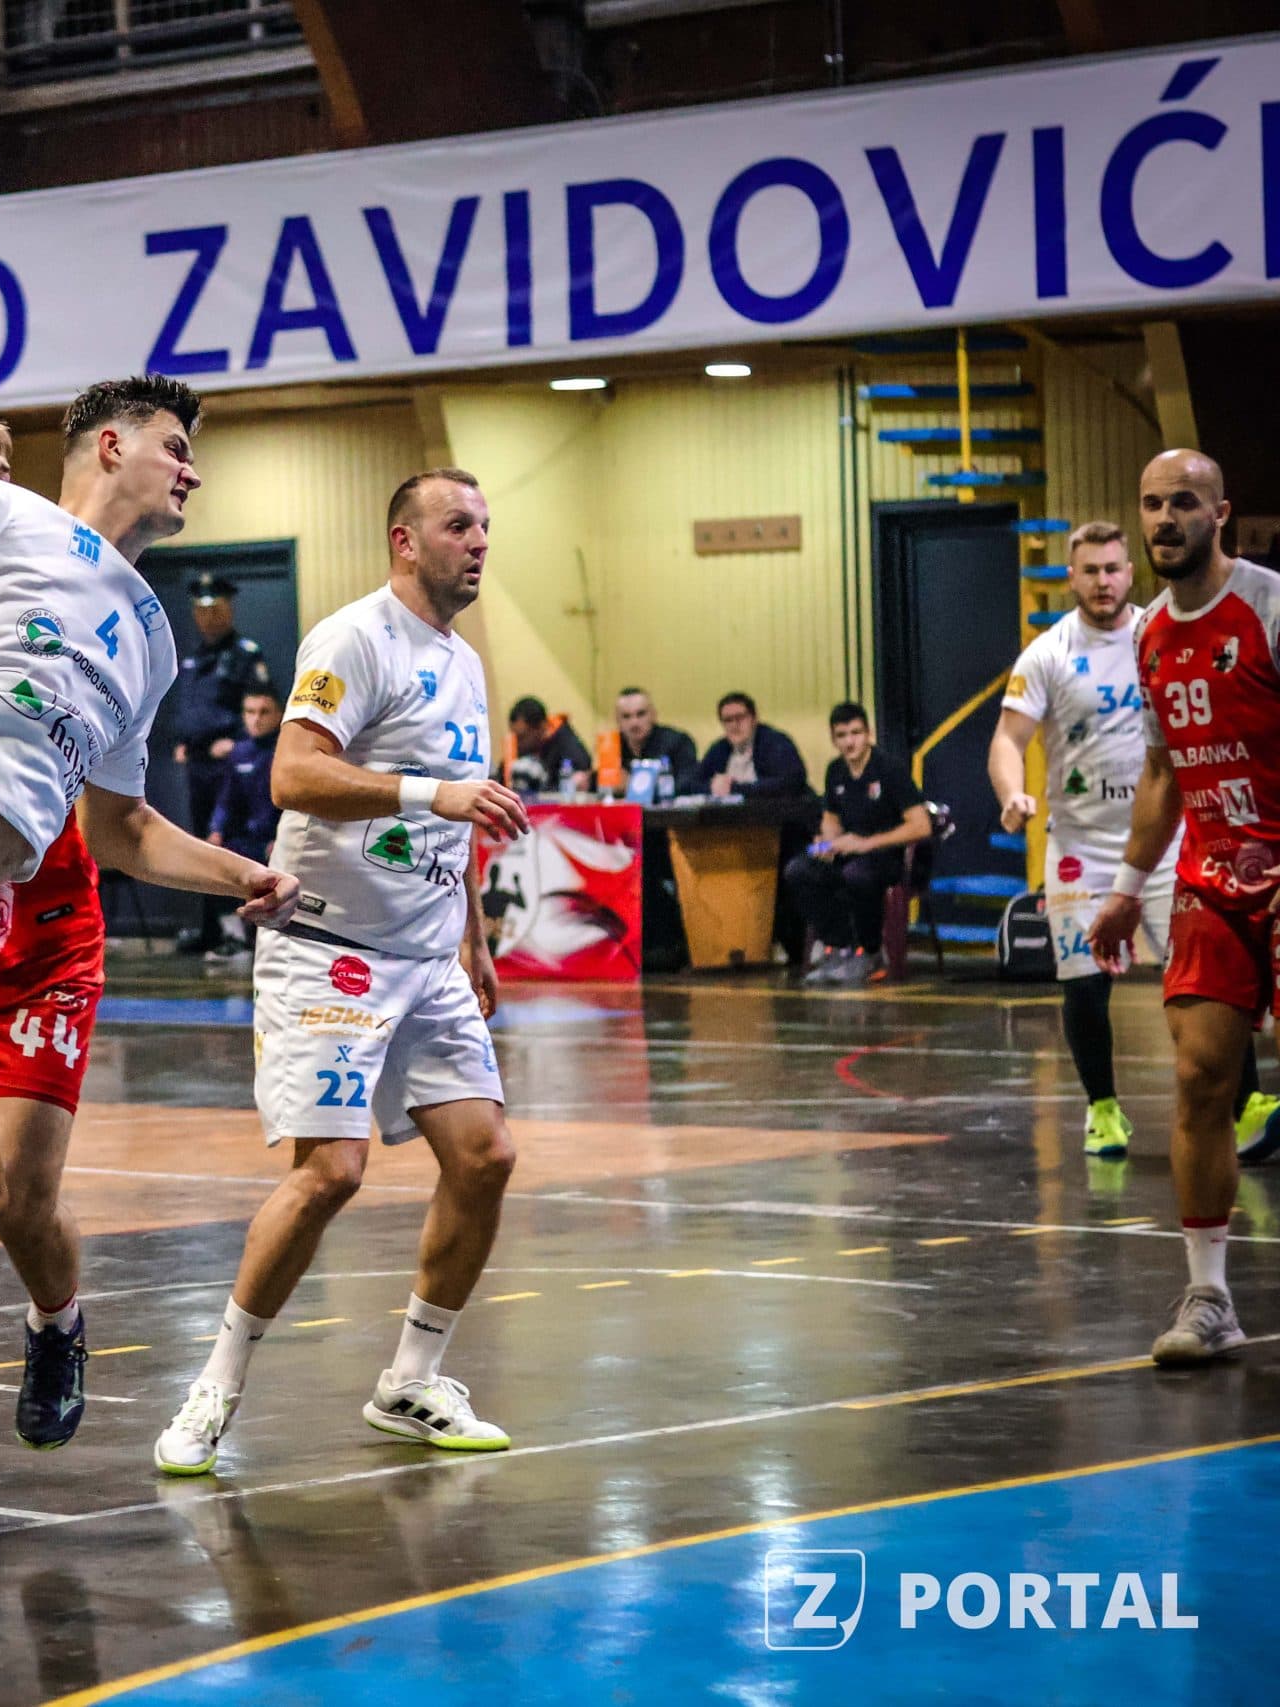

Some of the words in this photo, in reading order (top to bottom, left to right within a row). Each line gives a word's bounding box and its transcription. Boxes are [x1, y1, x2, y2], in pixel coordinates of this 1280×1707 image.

[95, 609, 120, 661] 4
[1096, 683, 1143, 715] 34
[1165, 678, 1213, 729] 39
[445, 721, 484, 764] 22
[10, 1008, 81, 1069] 44
[299, 1006, 395, 1031] ISOMAX
[316, 1070, 367, 1108] 22
